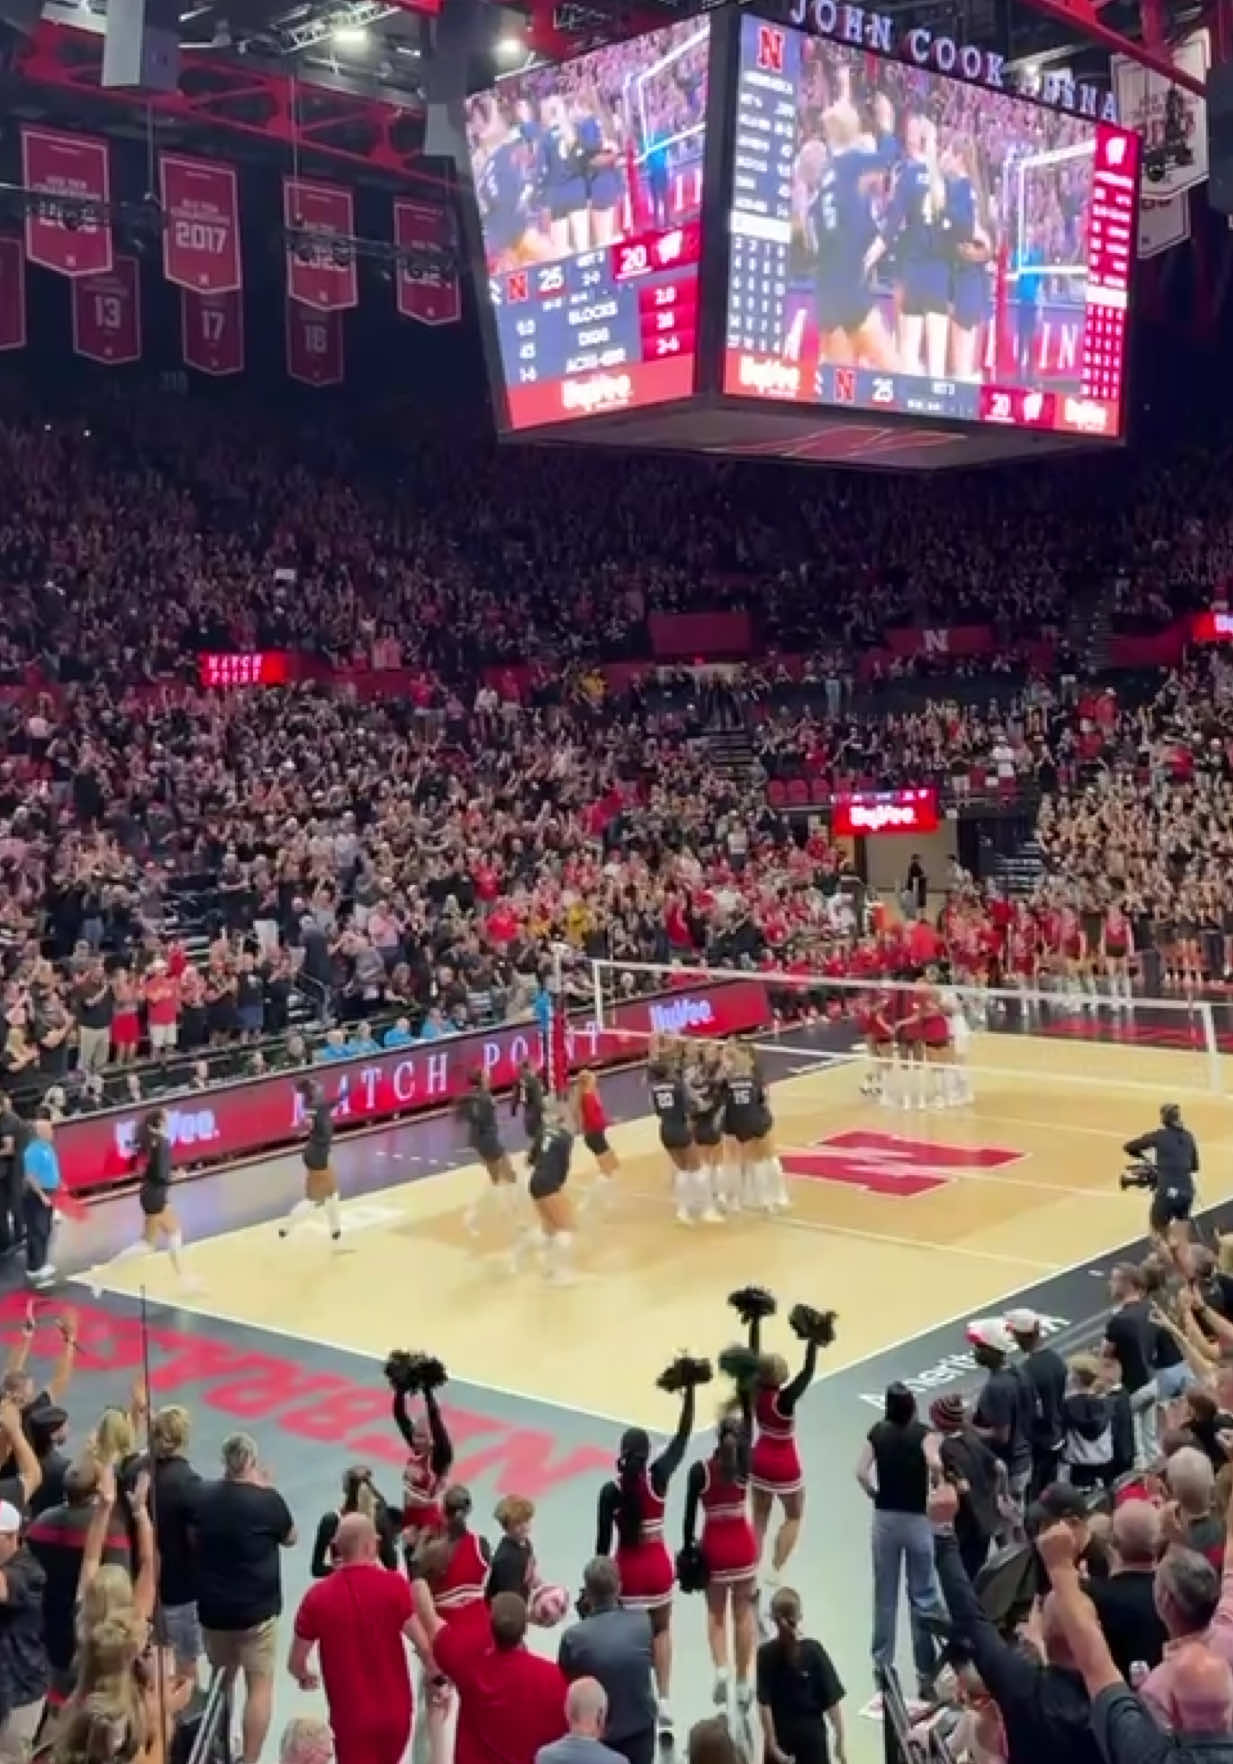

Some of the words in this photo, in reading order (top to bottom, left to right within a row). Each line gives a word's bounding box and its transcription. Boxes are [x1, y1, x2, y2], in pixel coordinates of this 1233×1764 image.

[907, 28, 1005, 87] COOK
[175, 221, 227, 254] 2017
[95, 296, 122, 328] 13
[201, 310, 226, 343] 17
[923, 630, 949, 652] N
